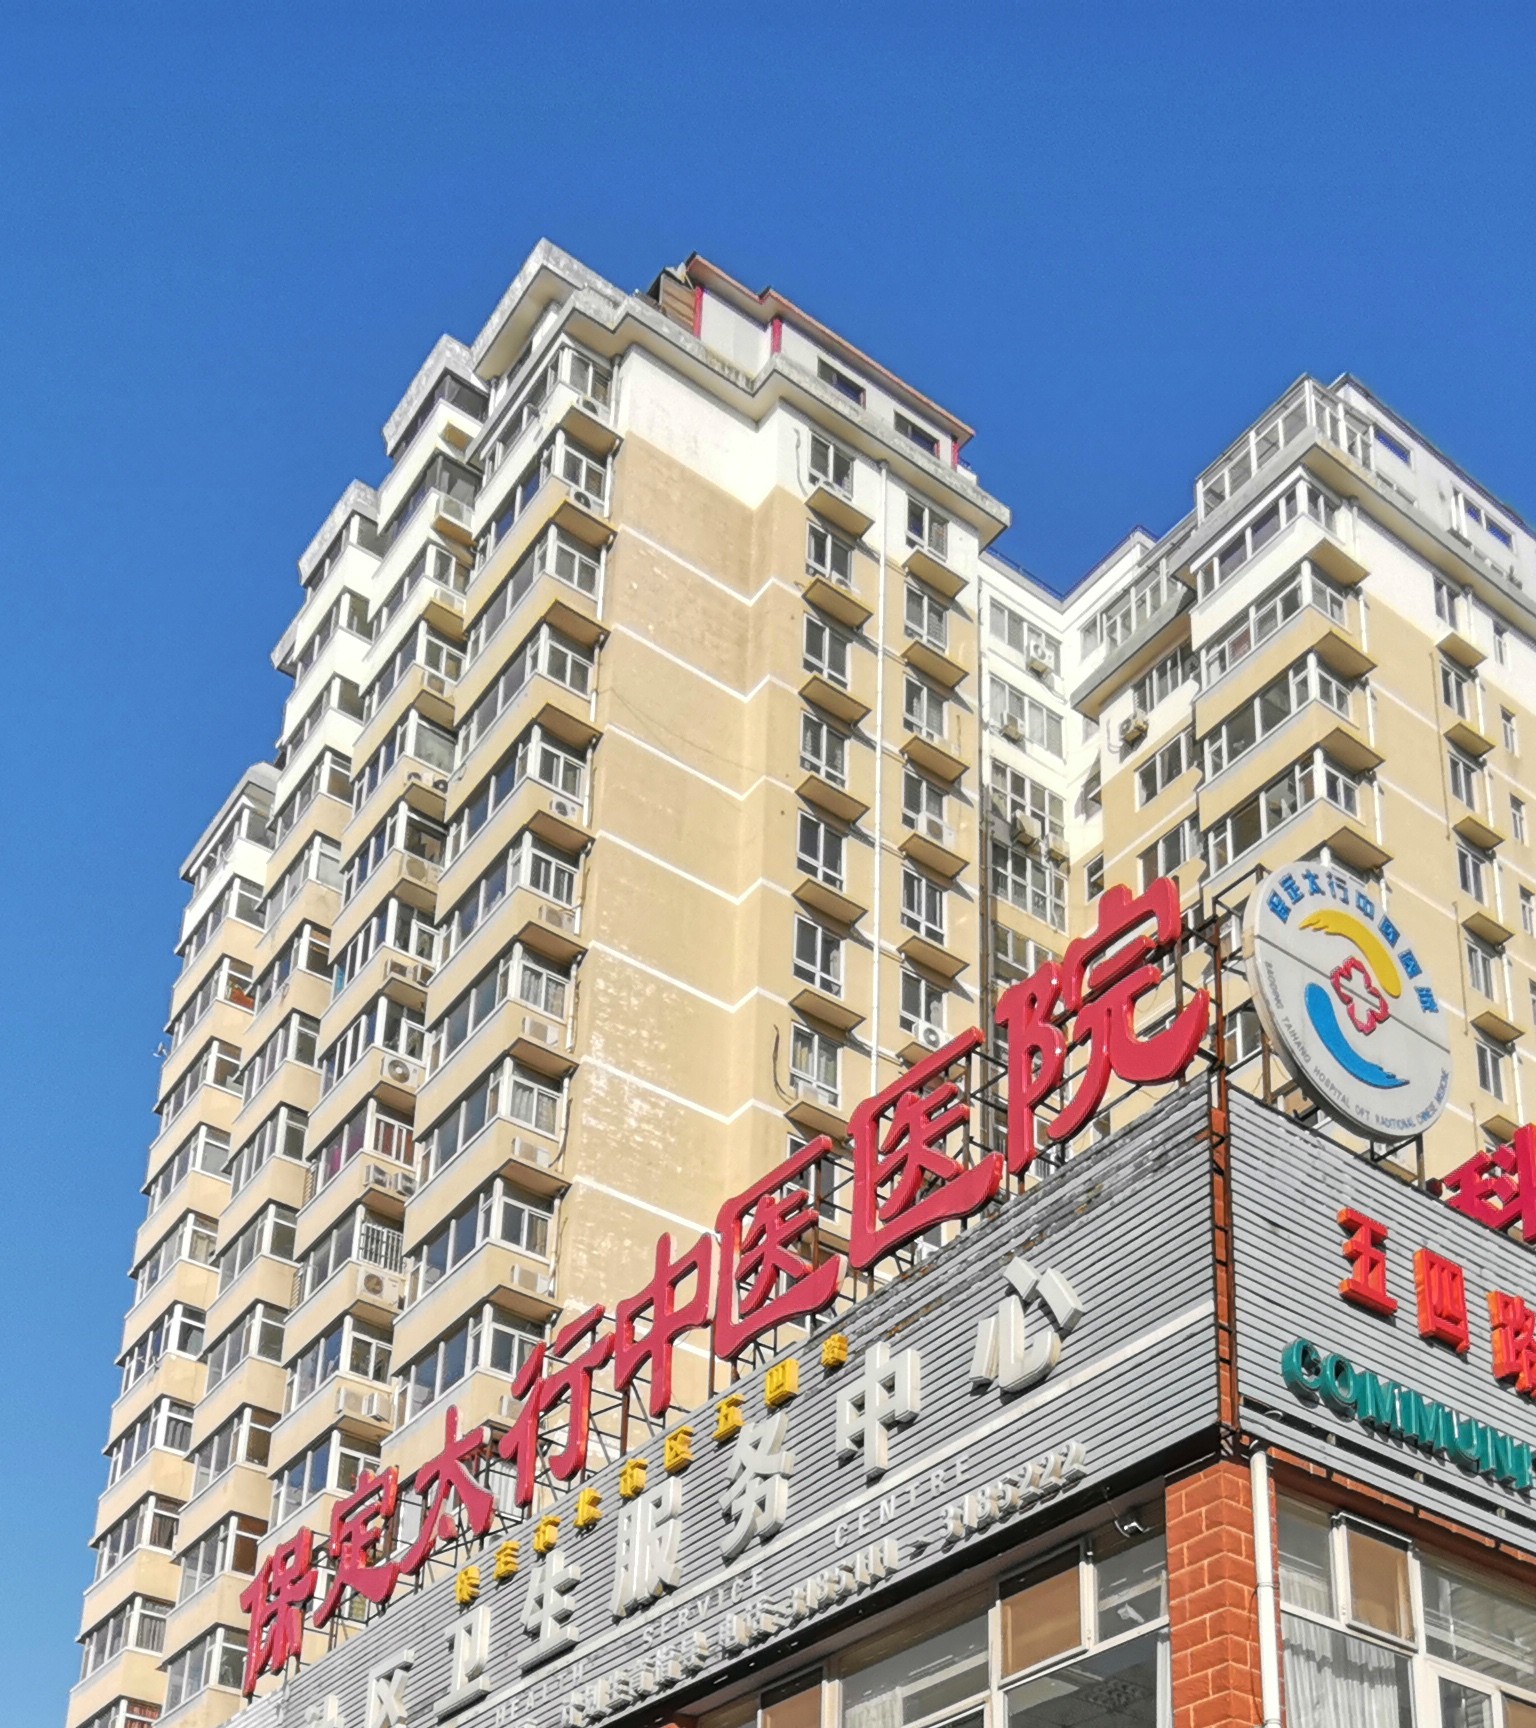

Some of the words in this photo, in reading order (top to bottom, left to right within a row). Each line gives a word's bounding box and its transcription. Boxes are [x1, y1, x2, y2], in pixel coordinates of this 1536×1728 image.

[241, 876, 1210, 1695] 保定太行中医医院
[642, 1567, 765, 1650] SERVICE
[833, 1454, 971, 1550] CENTRE
